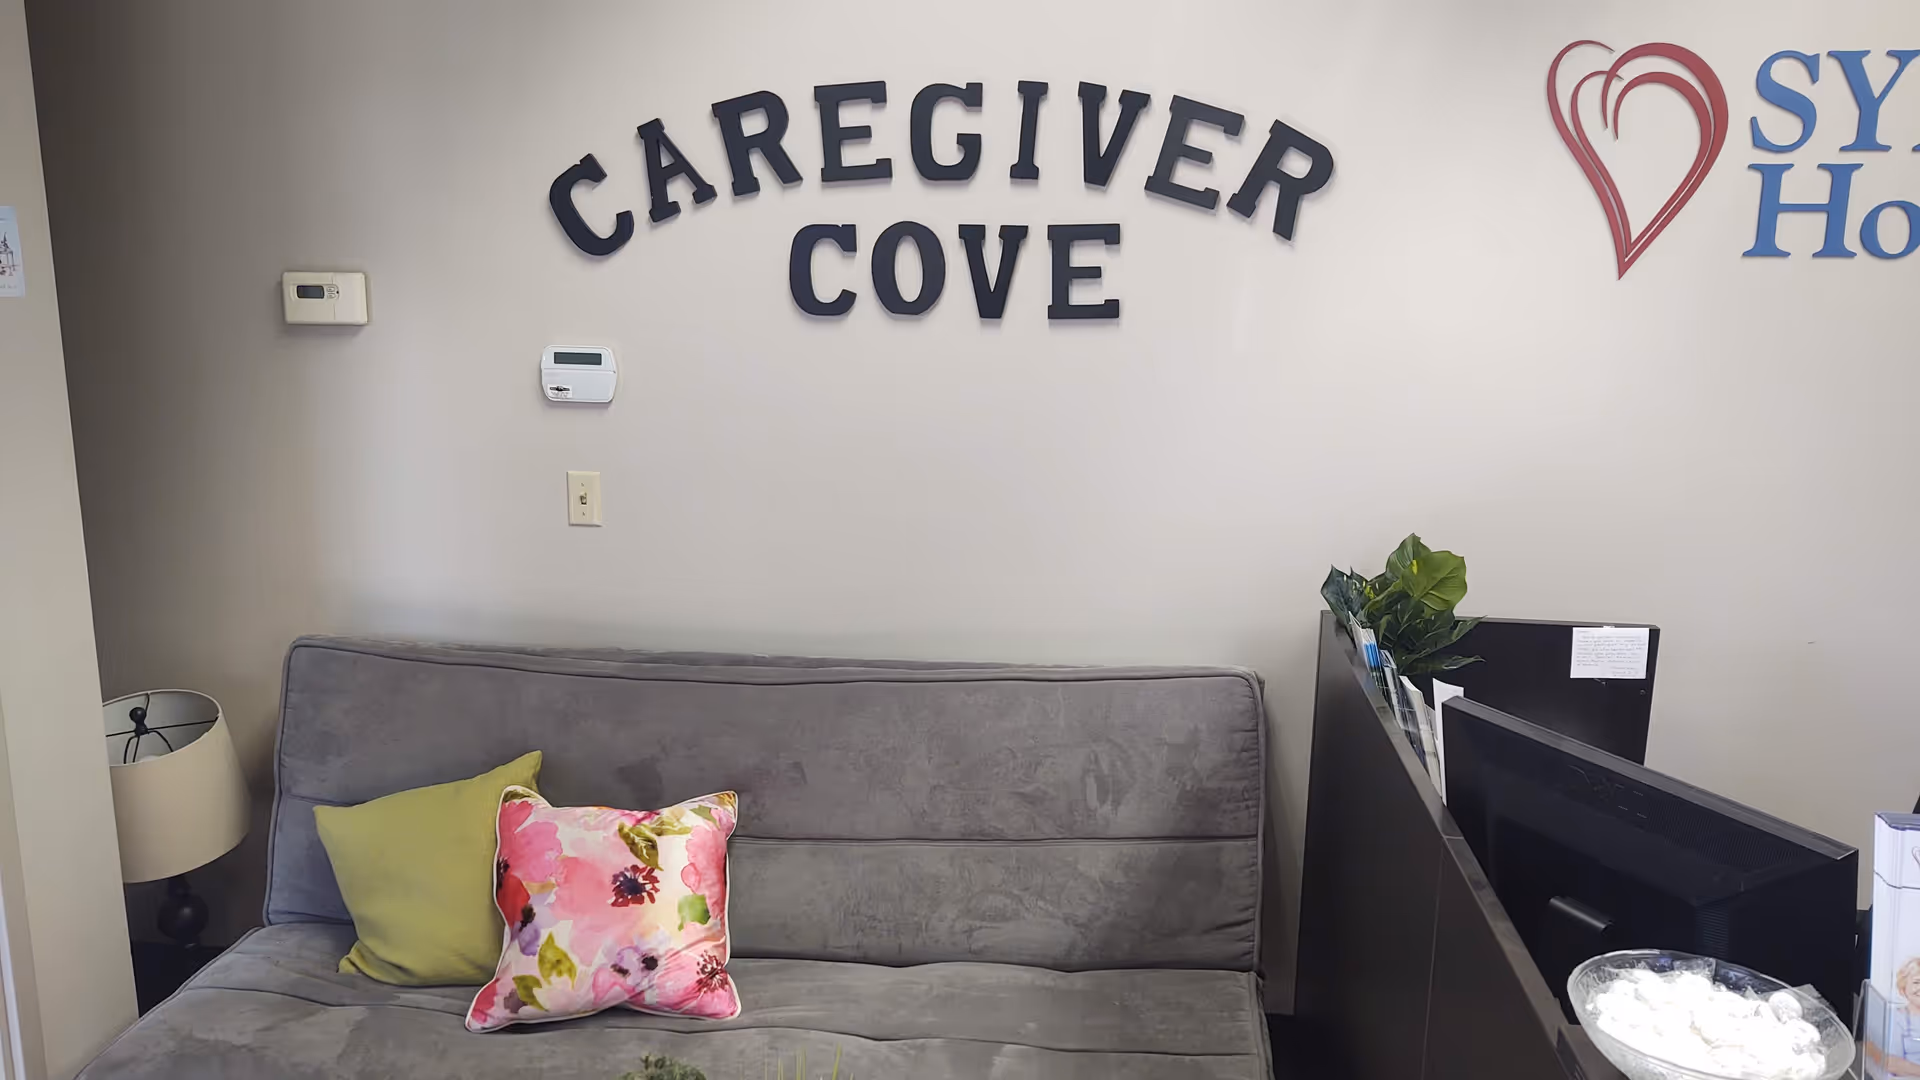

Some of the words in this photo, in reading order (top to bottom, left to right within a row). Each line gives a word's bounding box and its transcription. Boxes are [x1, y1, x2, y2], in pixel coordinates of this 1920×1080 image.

[1750, 50, 1920, 153] SY
[548, 80, 1334, 257] CAREGIVER
[789, 221, 1121, 319] COVE
